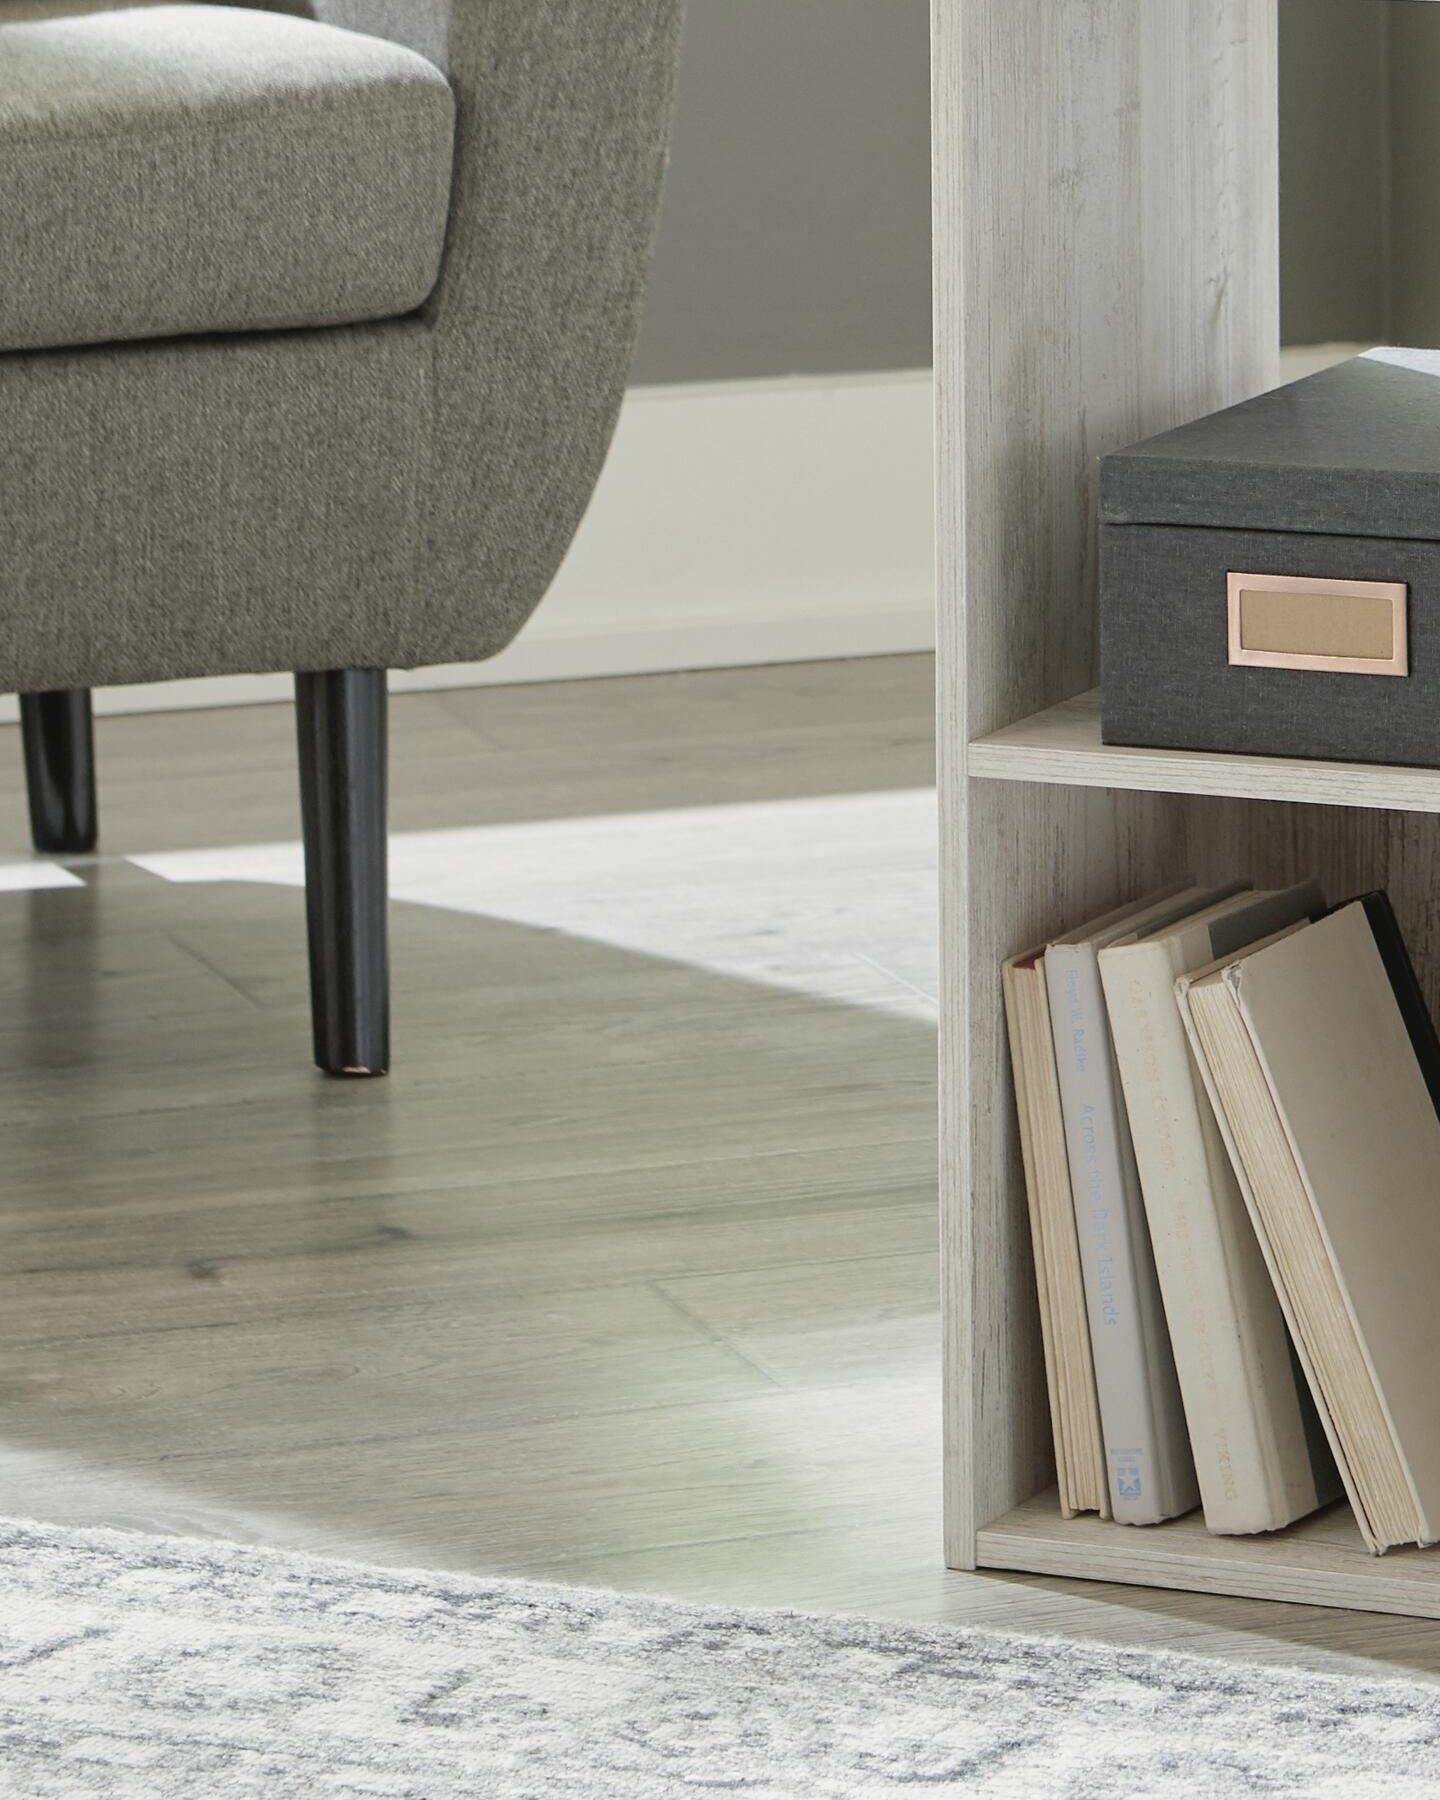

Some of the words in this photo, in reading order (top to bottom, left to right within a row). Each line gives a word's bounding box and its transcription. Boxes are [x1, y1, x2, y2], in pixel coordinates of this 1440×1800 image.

[1080, 1103, 1098, 1166] Across
[1088, 1170, 1104, 1201] the
[1093, 1208, 1110, 1252] Dark
[1098, 1256, 1121, 1327] Islands
